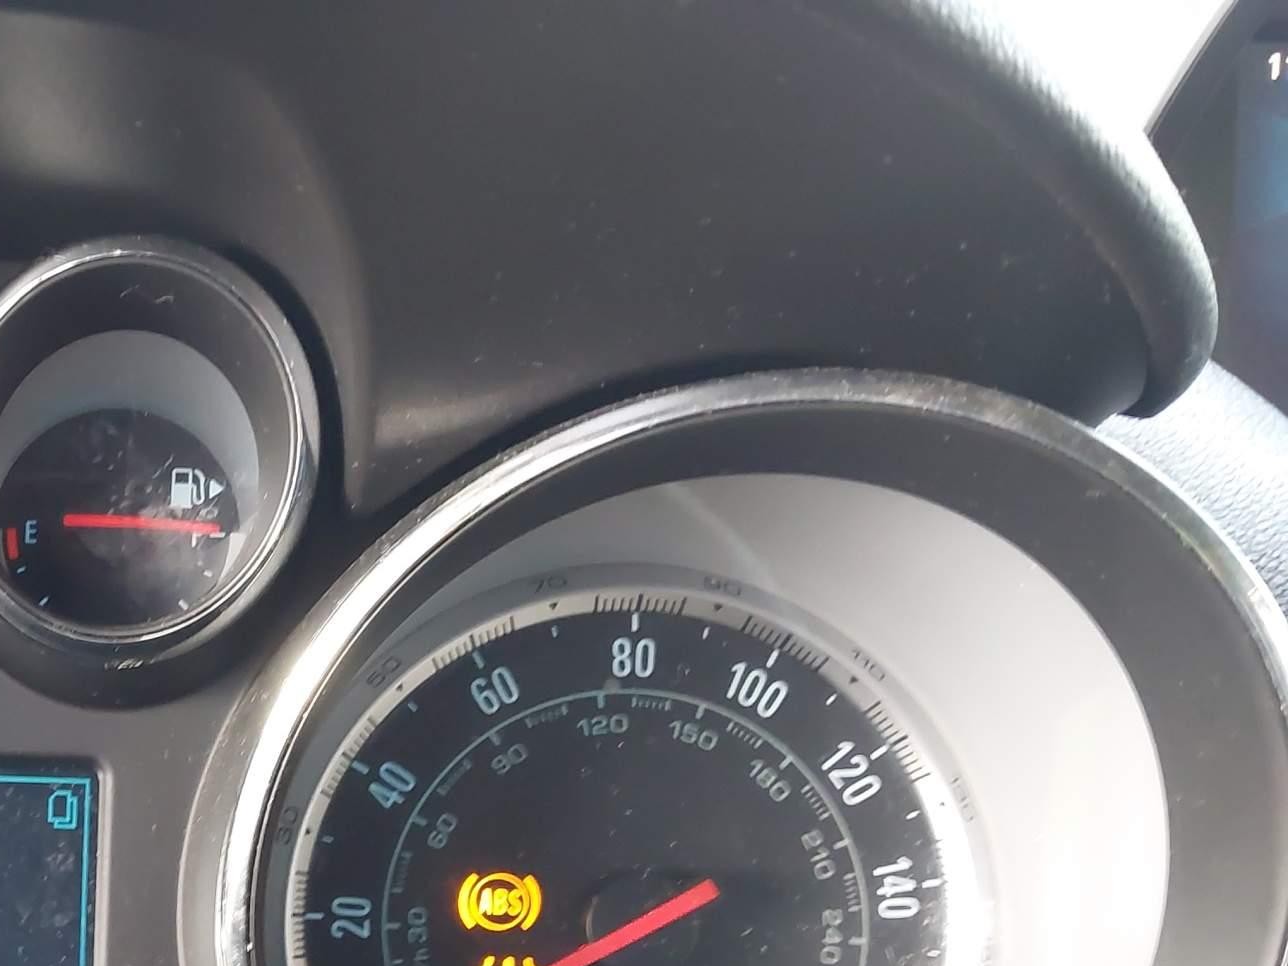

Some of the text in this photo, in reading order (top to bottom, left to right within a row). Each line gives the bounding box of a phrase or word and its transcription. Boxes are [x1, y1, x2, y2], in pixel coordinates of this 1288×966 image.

[24, 519, 37, 545] E
[611, 637, 656, 678] 80
[470, 666, 520, 715] 60
[726, 661, 789, 718] 100
[576, 714, 628, 737] 120
[668, 719, 719, 751] 150
[491, 743, 528, 776] 90
[749, 759, 791, 801] 180
[821, 741, 882, 806] 120
[367, 760, 417, 809] 40
[427, 813, 457, 849] 60
[801, 829, 836, 880] 210
[479, 888, 523, 917] ABS
[872, 856, 920, 919] 140
[330, 896, 372, 939] 20
[408, 907, 428, 943] 30
[820, 908, 844, 965] 240
